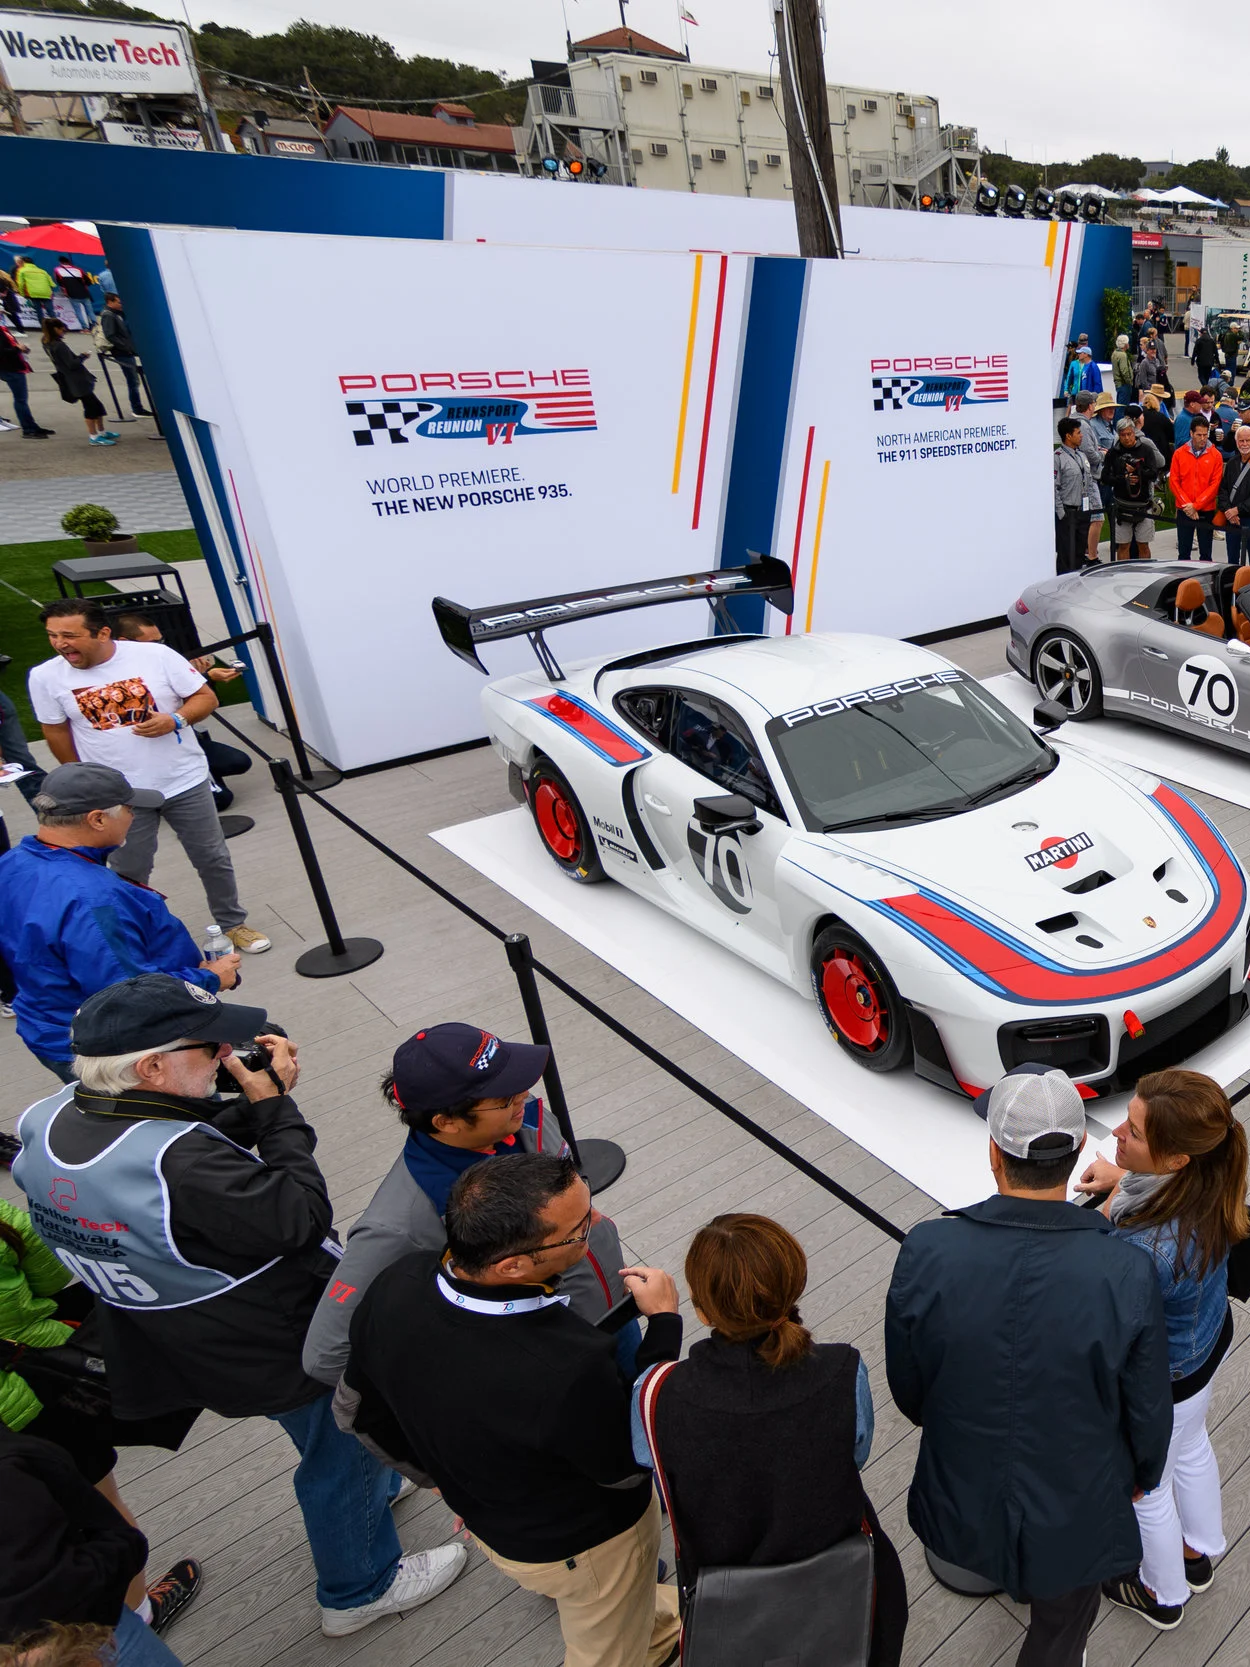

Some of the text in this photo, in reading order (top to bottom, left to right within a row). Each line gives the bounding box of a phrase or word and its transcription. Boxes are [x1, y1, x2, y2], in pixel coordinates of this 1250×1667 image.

[52, 66, 151, 81] Automotive Accessories
[122, 125, 197, 138] WeaherTech
[871, 355, 1008, 373] PORSCHE
[339, 369, 591, 394] PORSCHE
[925, 380, 966, 392] RENNSPORT
[913, 392, 945, 404] REUNION
[945, 395, 964, 412] VI
[446, 403, 519, 419] RENNSPORT
[427, 419, 483, 435] REUNION
[485, 422, 518, 446] VI
[877, 424, 1009, 447] NORTH AMERICAN PREMIERE.
[877, 439, 1018, 464] THE 911 SPEEDSTER CONCEPT.
[366, 467, 525, 495] WORLD PREMIERE.
[372, 483, 573, 517] THE NEW PORSCHE 935.
[480, 575, 752, 628] PORSCHE
[782, 671, 964, 728] PORSCHE
[1185, 664, 1235, 717] 70
[593, 816, 616, 835] Mobil
[1027, 832, 1093, 872] MARTINI
[35, 1212, 121, 1249] Raceway
[84, 1245, 128, 1258] SECA
[55, 1247, 159, 1303] 075
[503, 1302, 514, 1312] 70
